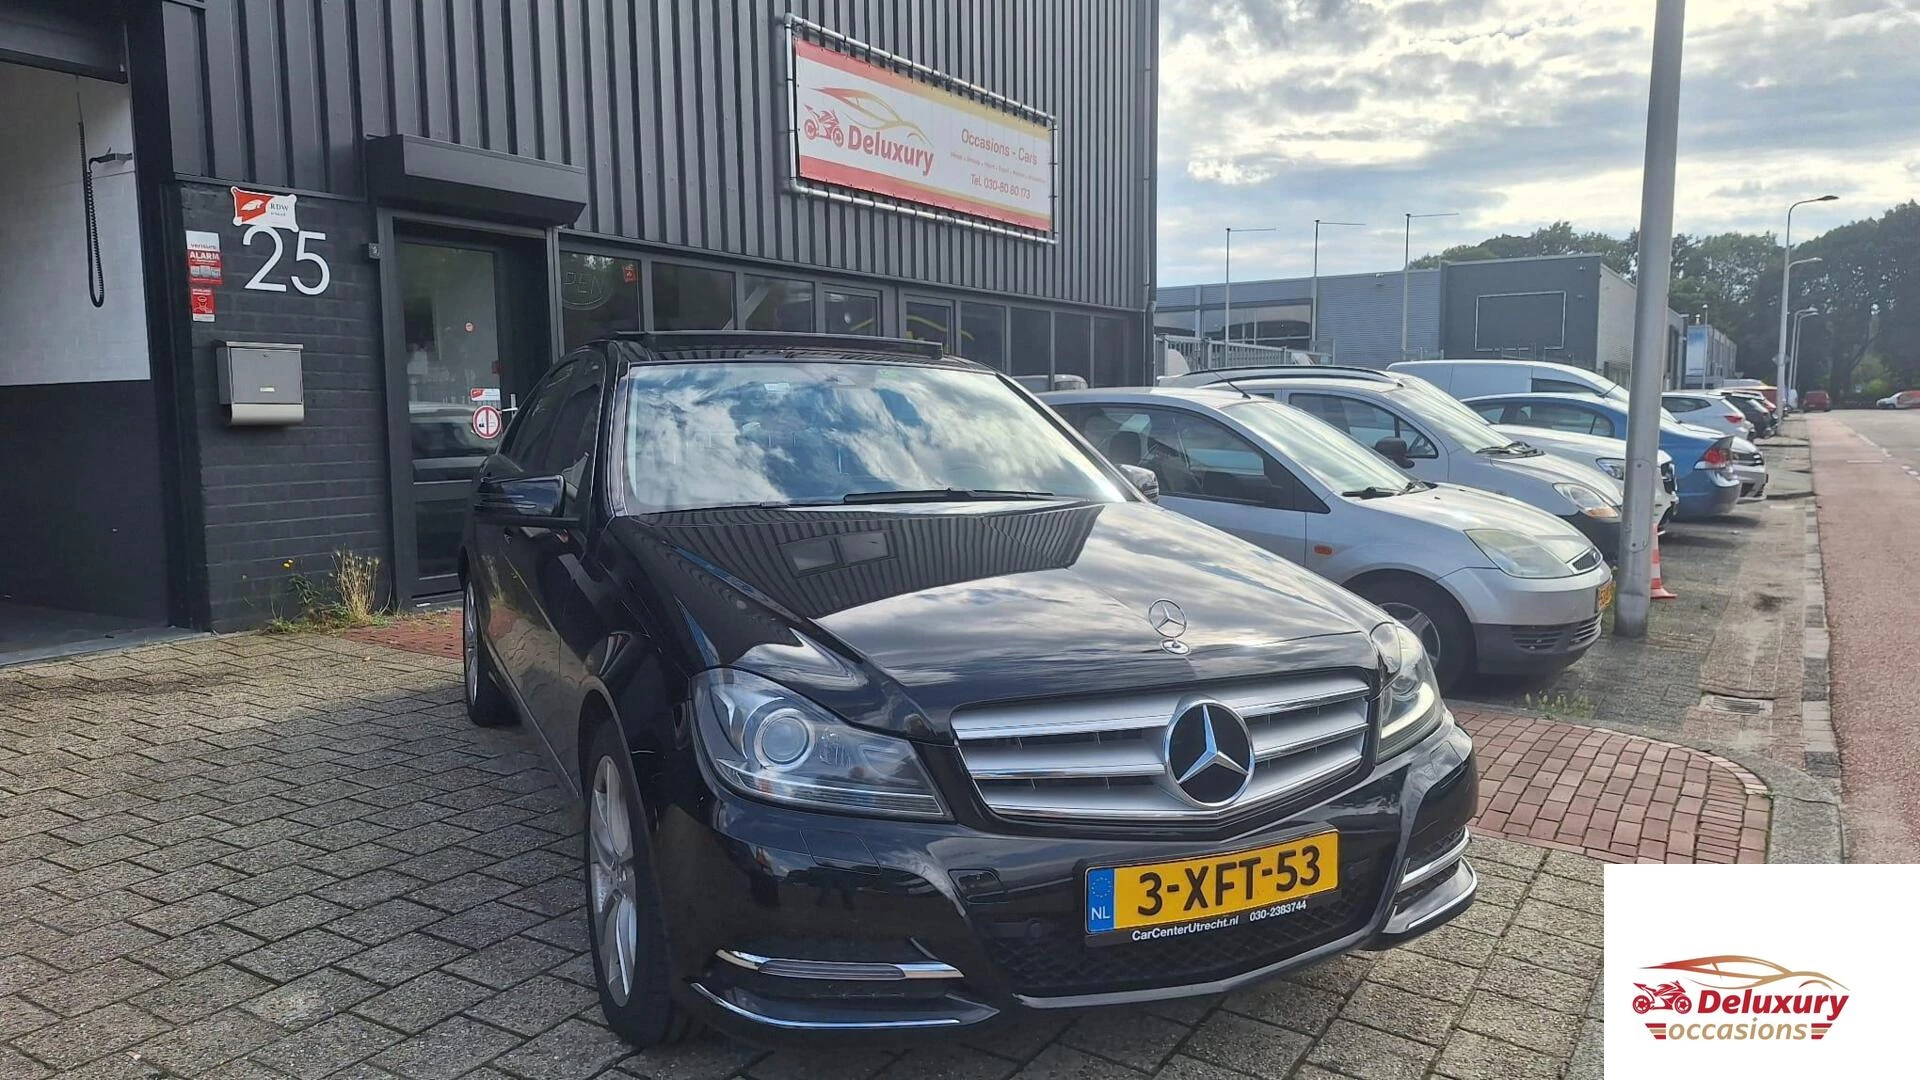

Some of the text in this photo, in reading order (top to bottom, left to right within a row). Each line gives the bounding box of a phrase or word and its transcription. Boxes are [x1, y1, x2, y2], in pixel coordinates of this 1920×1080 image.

[848, 125, 934, 176] Deluxury
[961, 128, 1010, 157] Occasions
[1018, 147, 1038, 166] Cars
[270, 203, 288, 211] RDW
[190, 250, 220, 260] ALARM
[242, 225, 330, 296] 25
[1137, 844, 1321, 917] 3-XFT-53
[1091, 906, 1110, 920] NL
[1131, 900, 1307, 942] CarCenterUtrecht.nl 030-2383744
